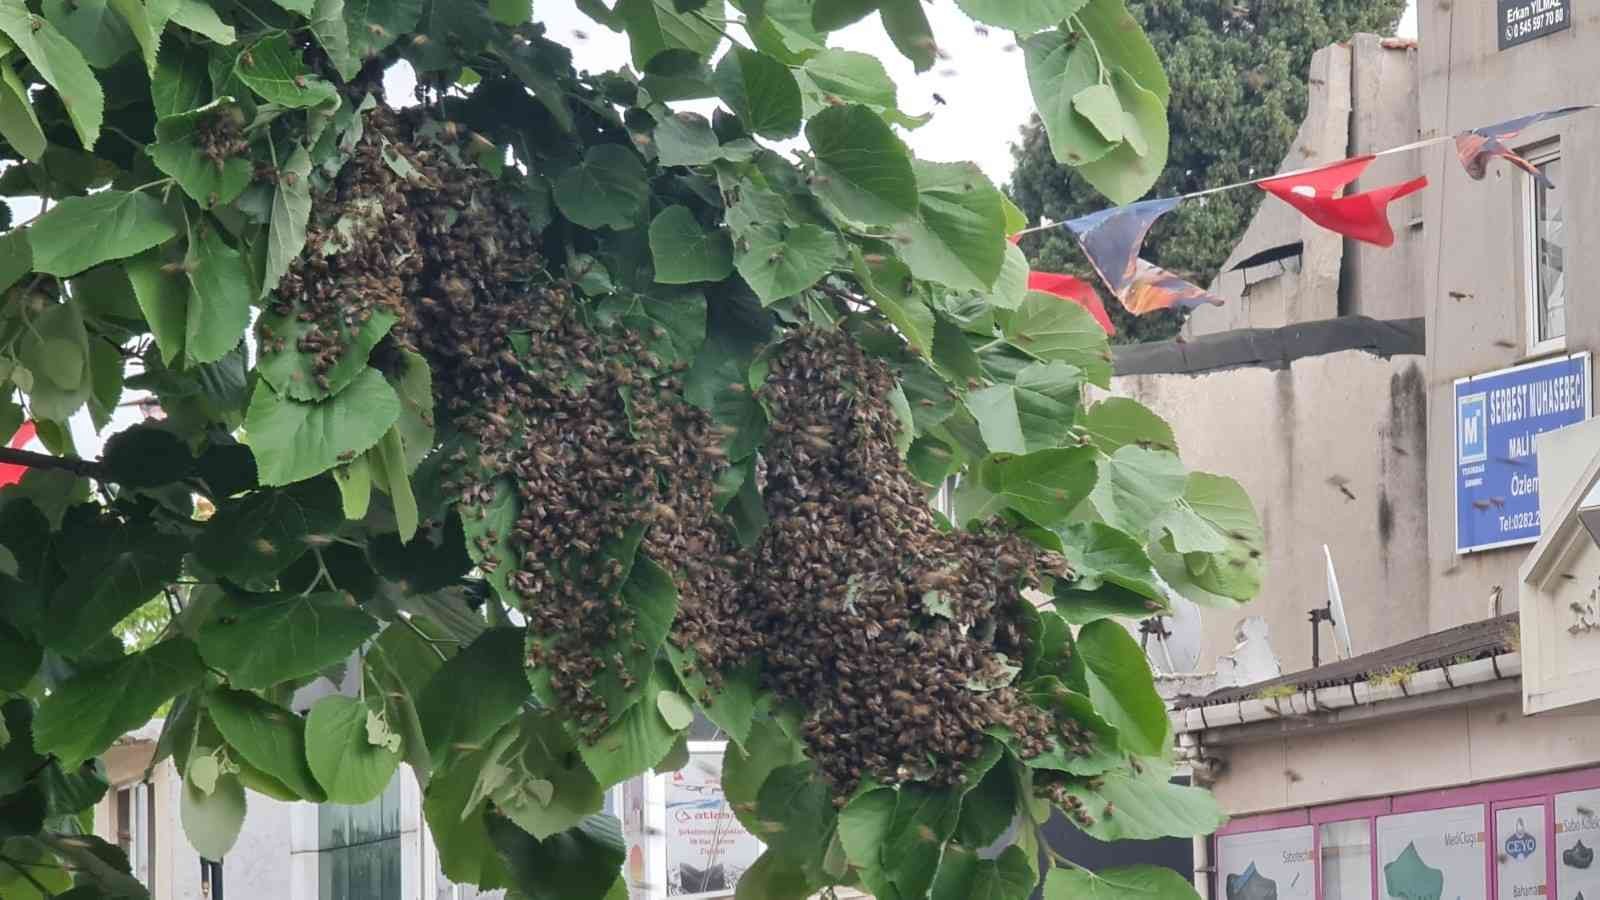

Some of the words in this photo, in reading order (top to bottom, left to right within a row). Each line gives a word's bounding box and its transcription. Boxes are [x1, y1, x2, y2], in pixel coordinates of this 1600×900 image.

[1507, 7, 1530, 24] Erkan
[1513, 23, 1519, 38] 0
[1520, 18, 1532, 36] 545
[1490, 383, 1528, 425] SERBEST
[1508, 431, 1530, 459] MALİ
[1506, 839, 1536, 853] CEYO
